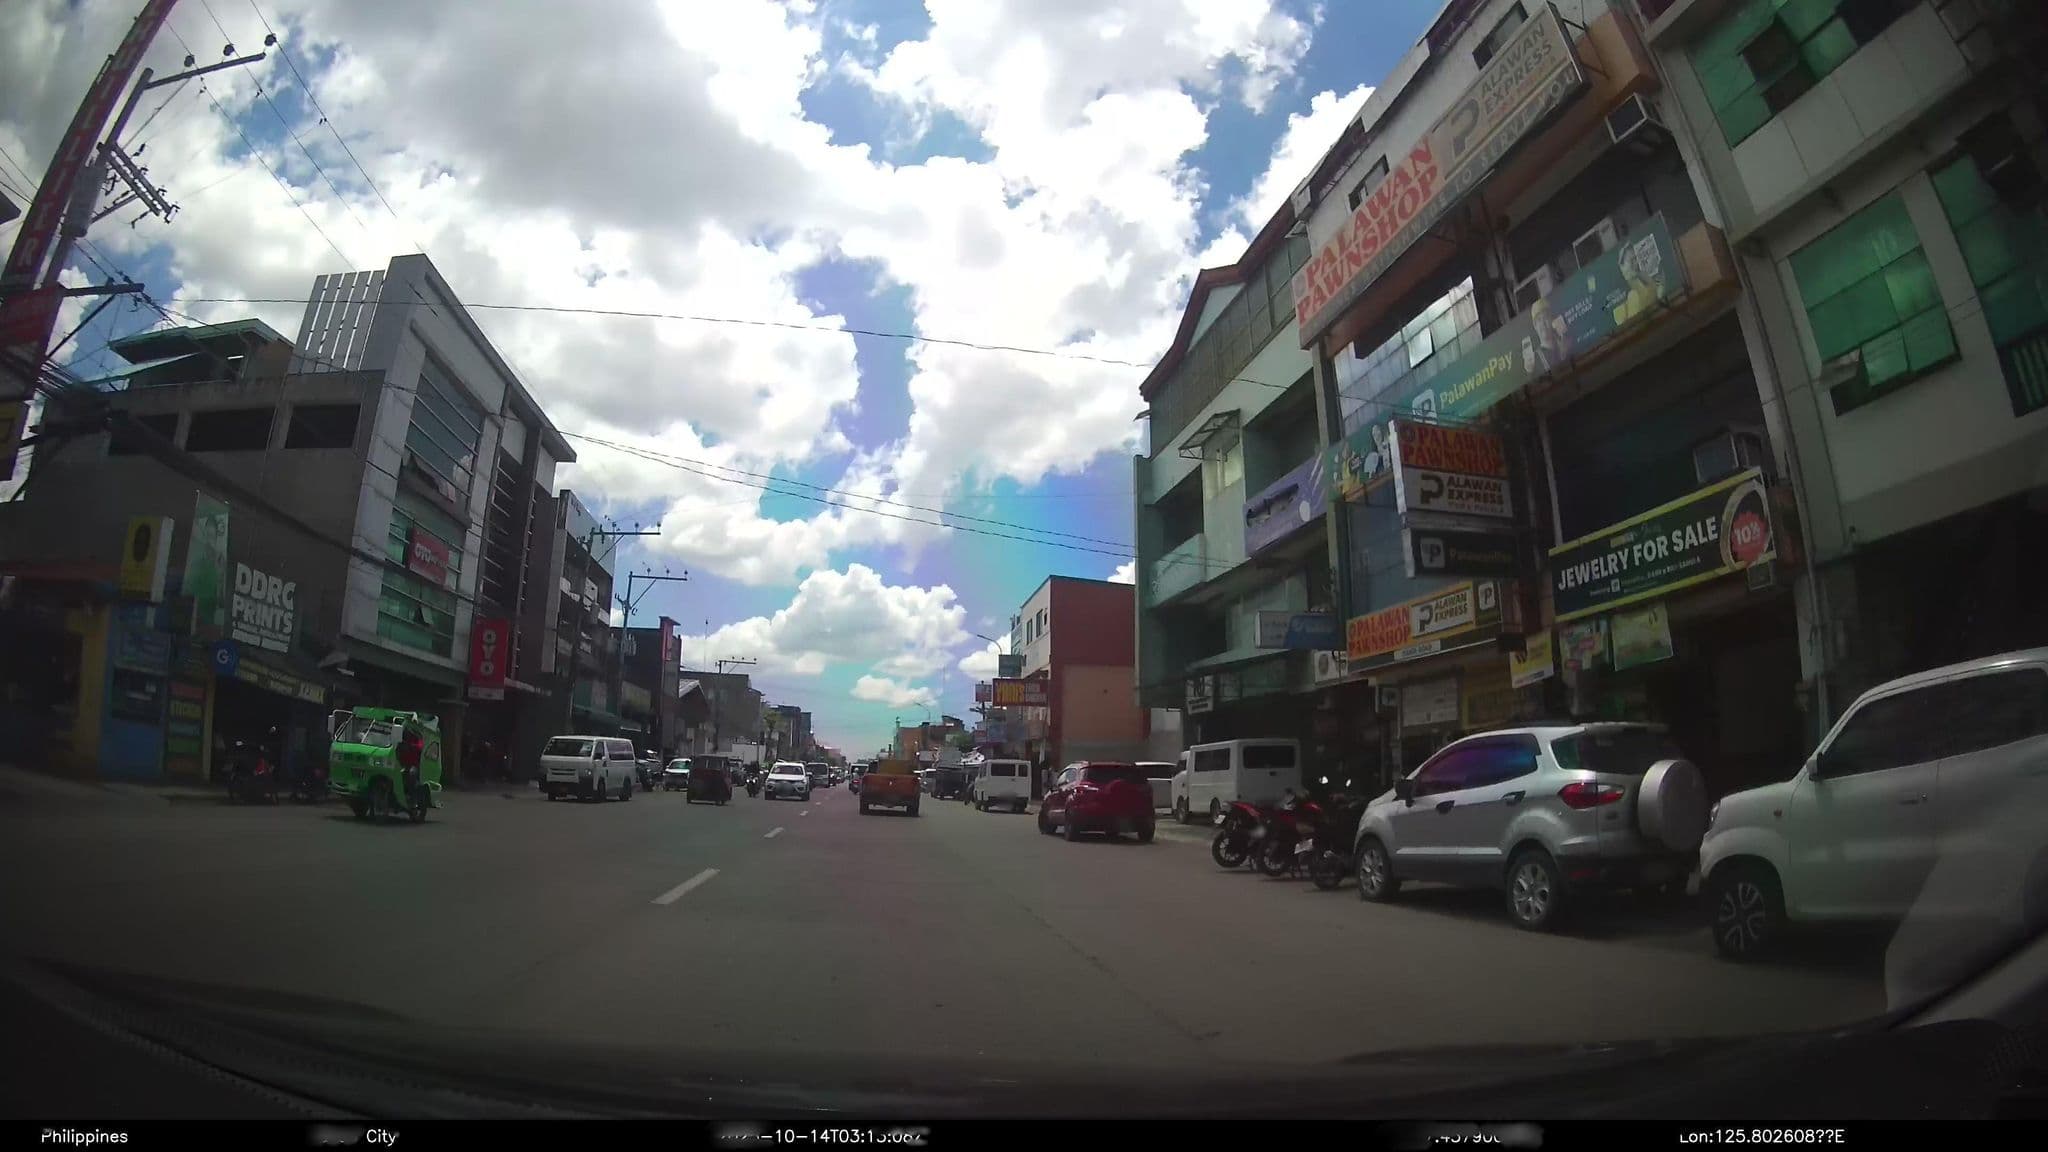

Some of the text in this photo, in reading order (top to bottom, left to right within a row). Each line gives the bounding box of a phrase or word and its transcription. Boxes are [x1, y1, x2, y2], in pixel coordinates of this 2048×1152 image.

[1481, 23, 1546, 97] ALAWAN
[1484, 40, 1553, 115] EXPRESS
[1305, 136, 1433, 289] PALAWAN
[1296, 165, 1438, 326] PAWNSHOP
[1439, 351, 1512, 411] PalawanPay
[1446, 475, 1503, 493] ALAWAN
[1557, 548, 1630, 592] JEWELRY
[1633, 535, 1669, 566] FOR
[1671, 516, 1719, 554] SALE
[1734, 522, 1761, 546] 10%
[231, 593, 294, 635] PRINTS
[1356, 606, 1409, 635] PALAWAN
[479, 629, 497, 677] OYO
